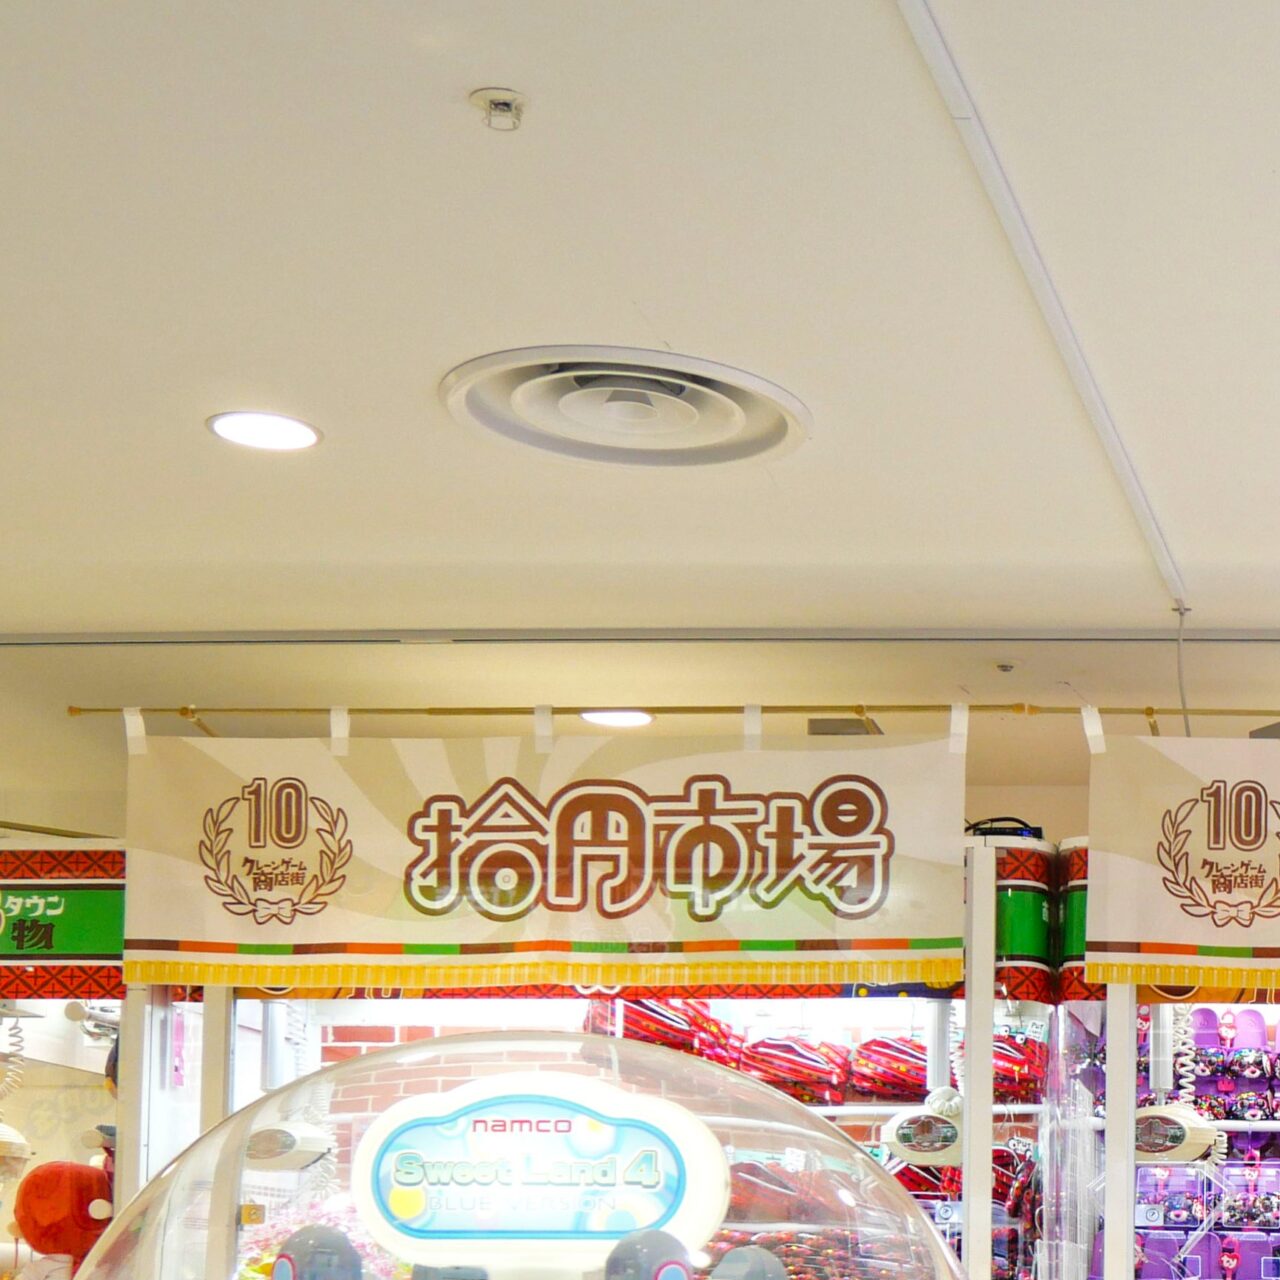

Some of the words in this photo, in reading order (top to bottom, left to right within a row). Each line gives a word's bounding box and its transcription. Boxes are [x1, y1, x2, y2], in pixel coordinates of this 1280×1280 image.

[242, 777, 308, 849] 10
[1200, 780, 1268, 852] 10
[404, 774, 894, 923] 拾円市場
[242, 856, 308, 876] クレーンゲーム
[1200, 858, 1267, 878] クレーンゲーム
[252, 872, 306, 892] 商店街
[1211, 874, 1265, 894] 商店街
[4, 895, 65, 917] タウン
[11, 918, 55, 950] 物
[472, 1119, 572, 1133] namco
[393, 1151, 514, 1187] Sweet
[623, 1150, 660, 1188] 4
[1222, 1254, 1237, 1269] ty
